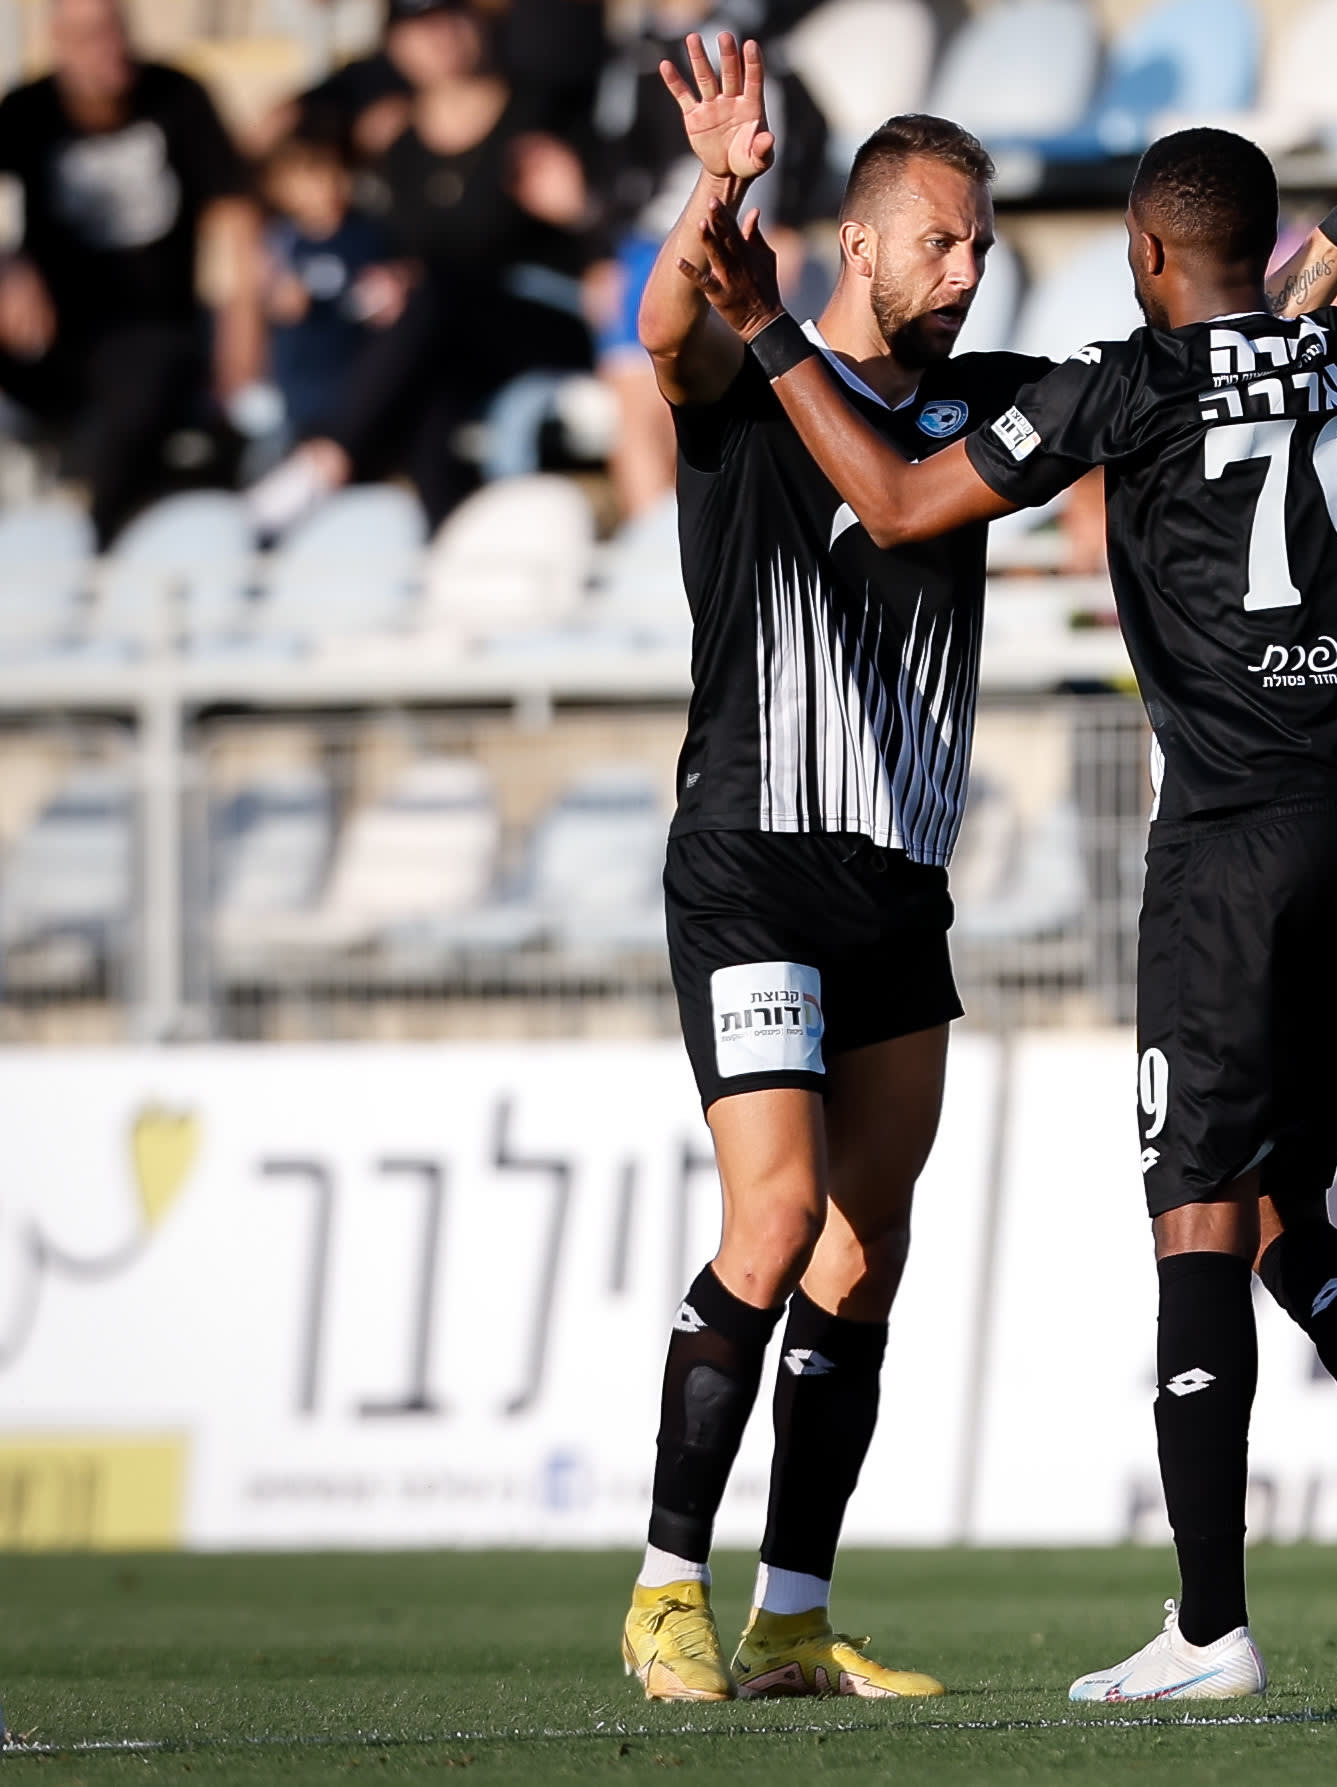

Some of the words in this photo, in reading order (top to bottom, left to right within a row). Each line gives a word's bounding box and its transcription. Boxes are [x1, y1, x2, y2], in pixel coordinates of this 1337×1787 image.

[1262, 674, 1306, 688] פסולת
[751, 990, 800, 1004] קבוצת
[720, 1006, 802, 1033] דורות
